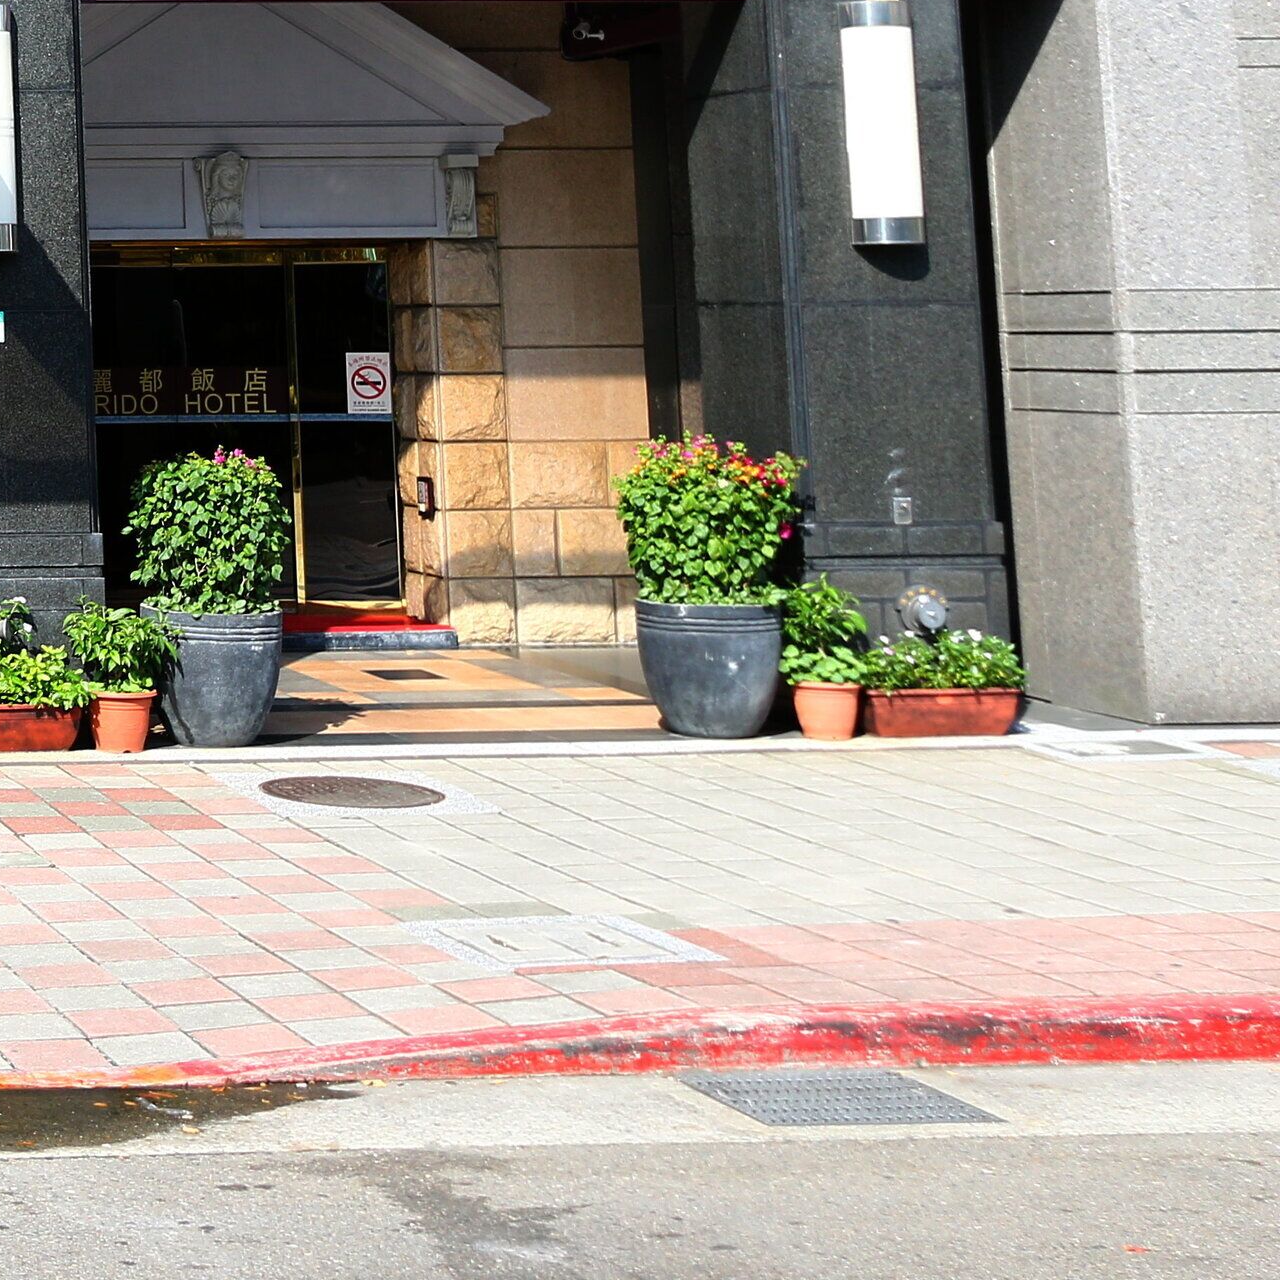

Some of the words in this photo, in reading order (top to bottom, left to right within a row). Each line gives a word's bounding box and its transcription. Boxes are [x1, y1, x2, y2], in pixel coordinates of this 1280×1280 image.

[93, 367, 268, 393] 麗都飯店
[94, 394, 159, 414] RIDO
[185, 392, 277, 414] HOTEL
